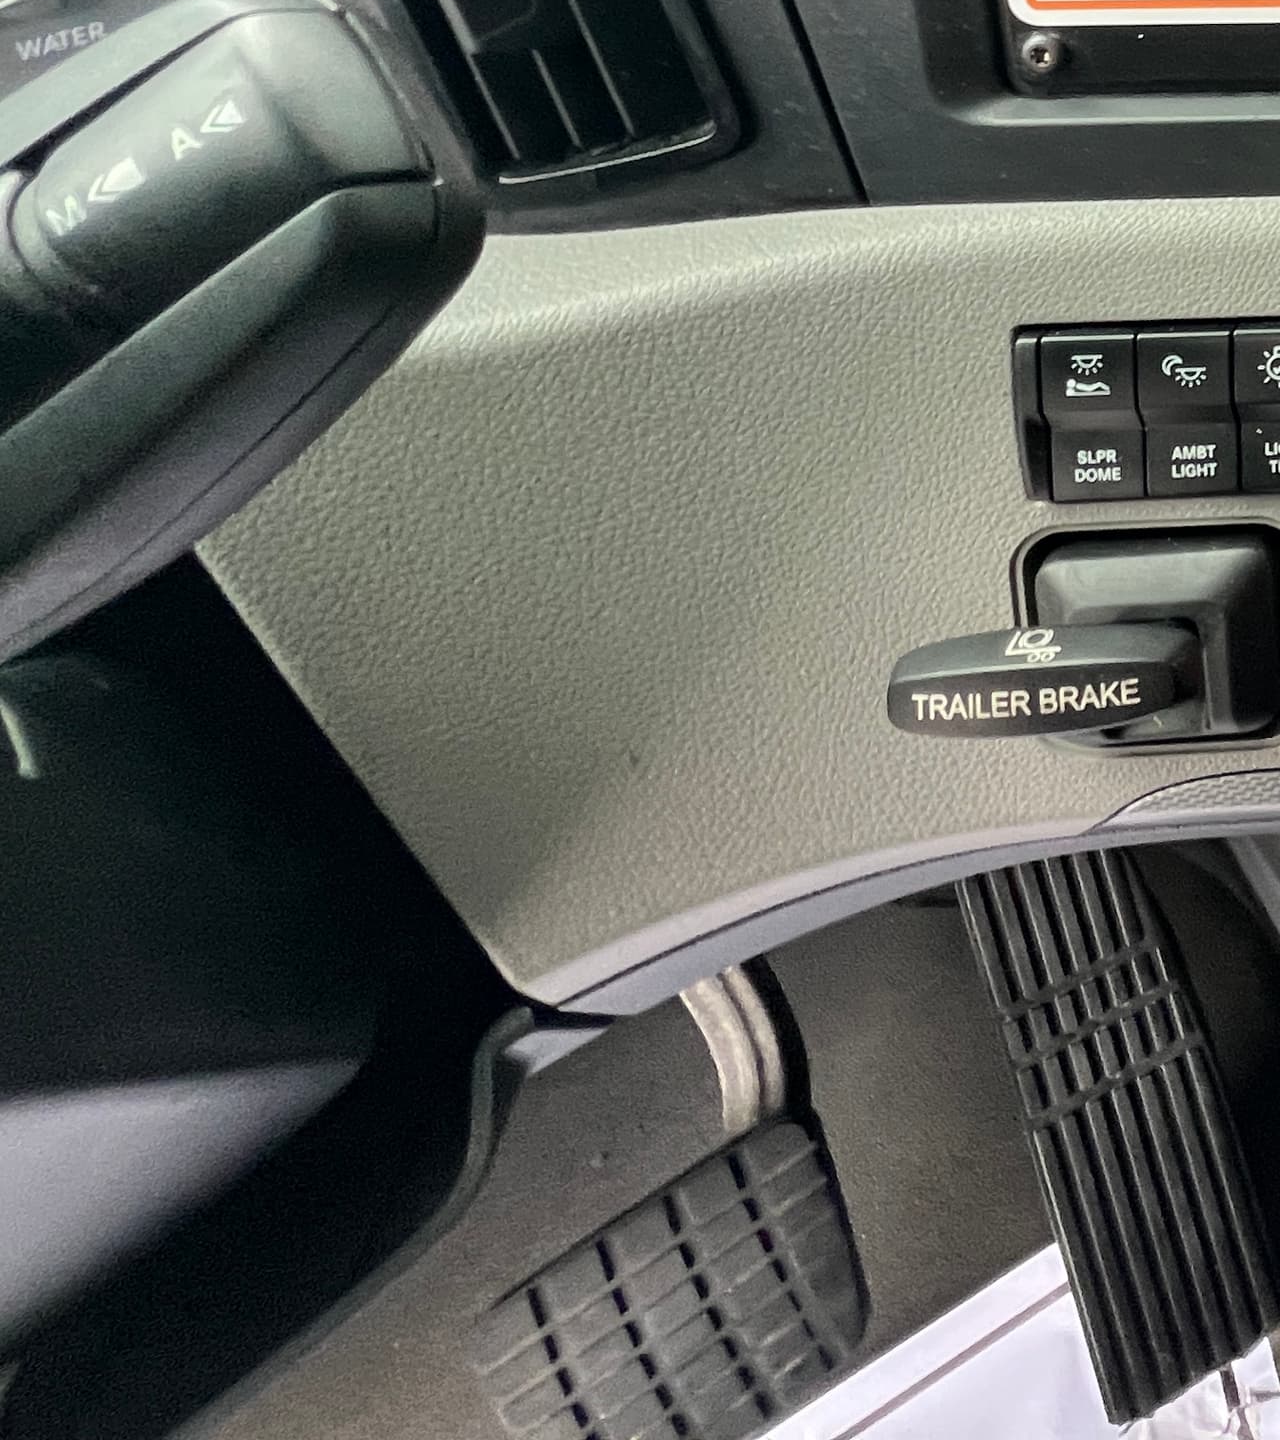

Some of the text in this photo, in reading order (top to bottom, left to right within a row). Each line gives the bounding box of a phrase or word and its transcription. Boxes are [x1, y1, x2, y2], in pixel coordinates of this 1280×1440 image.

[16, 22, 104, 60] WATER
[171, 128, 201, 160] A
[1077, 449, 1117, 465] SLPR
[1171, 444, 1217, 460] AMBT
[1074, 467, 1121, 483] DOME
[1171, 462, 1217, 479] LIGHT
[911, 678, 1141, 721] TRAILER BRAKE
